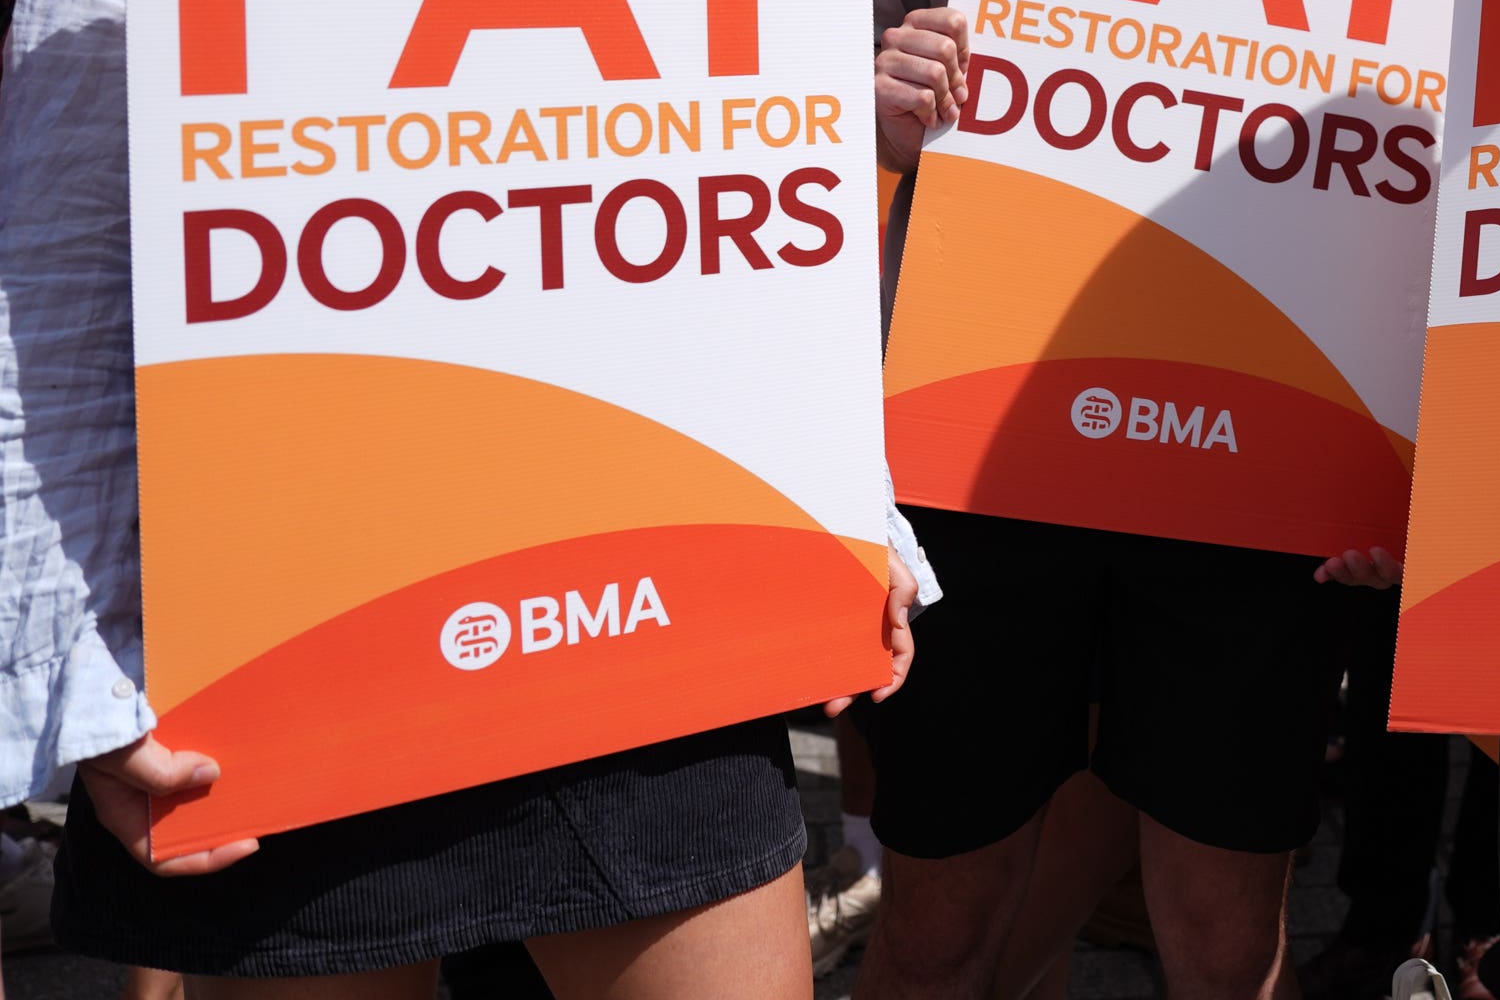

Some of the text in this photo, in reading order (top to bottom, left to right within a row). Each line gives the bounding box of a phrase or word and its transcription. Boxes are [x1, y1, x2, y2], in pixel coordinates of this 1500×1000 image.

[1348, 58, 1447, 114] FOR
[181, 95, 844, 182] RESTORATION FOR
[956, 51, 1437, 206] DOCTORS
[183, 166, 845, 325] DOCTORS
[1126, 396, 1239, 453] BMA
[519, 576, 672, 655] BMA
